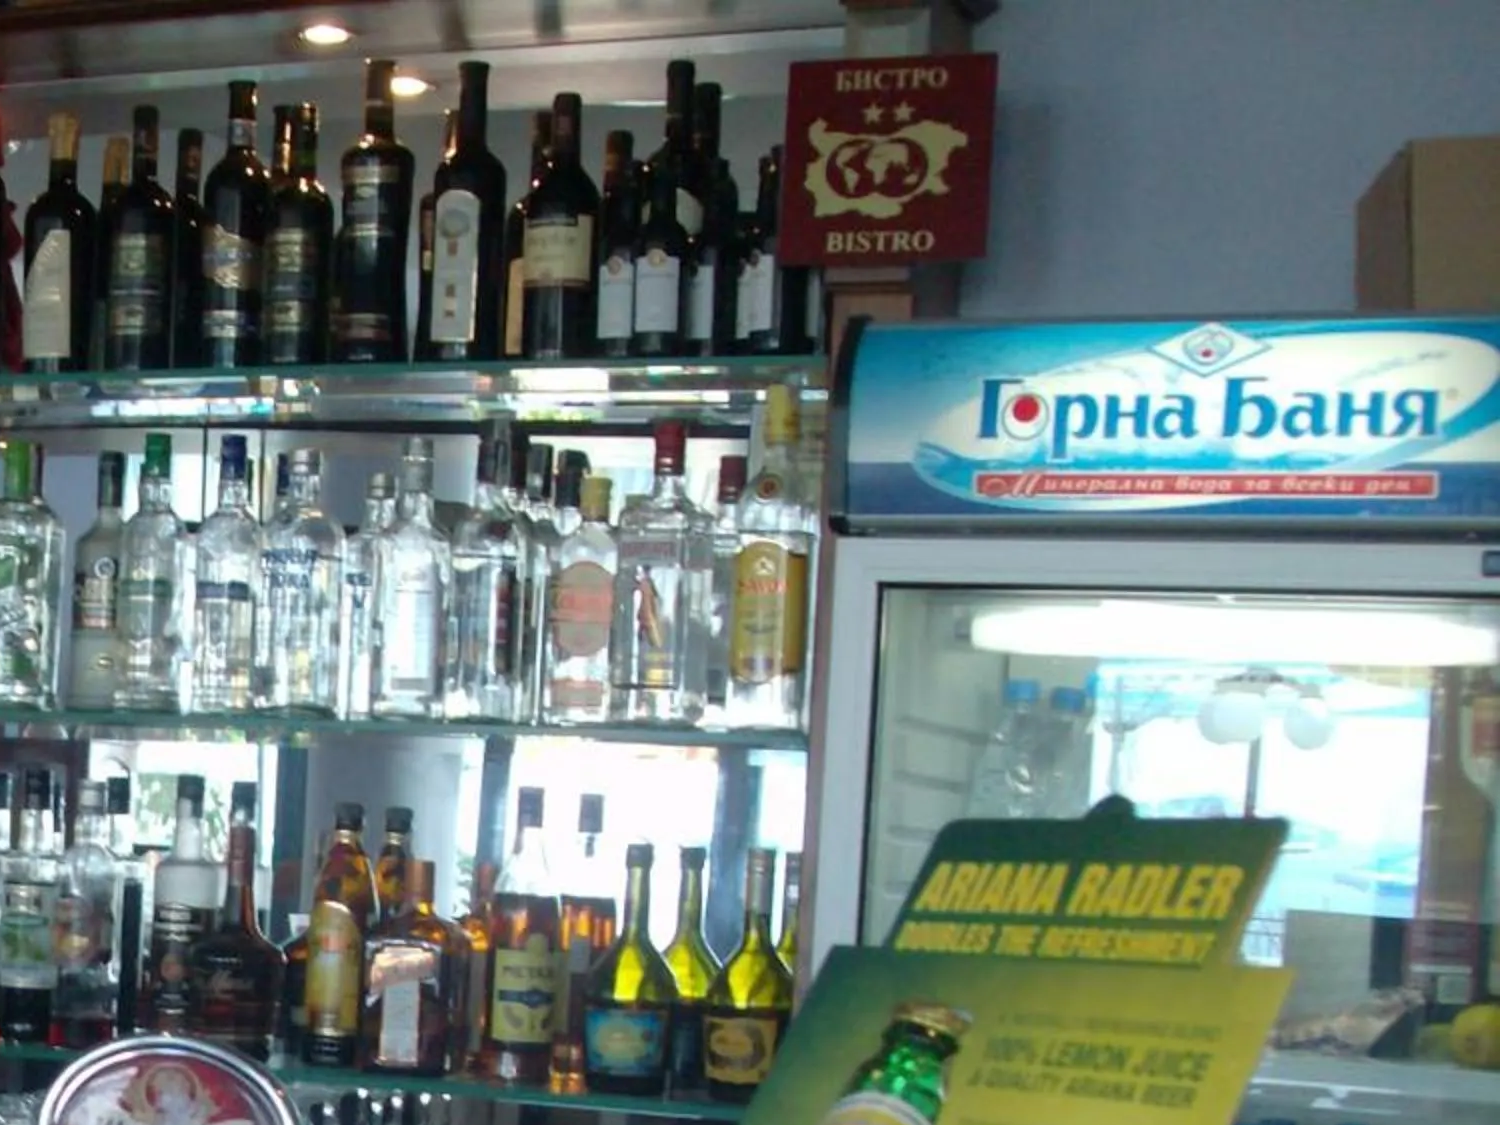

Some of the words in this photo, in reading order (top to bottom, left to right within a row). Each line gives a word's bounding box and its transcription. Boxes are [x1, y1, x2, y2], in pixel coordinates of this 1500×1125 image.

[835, 66, 949, 93] БИСТРО
[824, 229, 935, 255] BISTRO
[977, 378, 1198, 460] Горна
[1221, 377, 1438, 441] Баня
[913, 860, 1070, 915] ARIANA
[1065, 861, 1245, 921] RADLER
